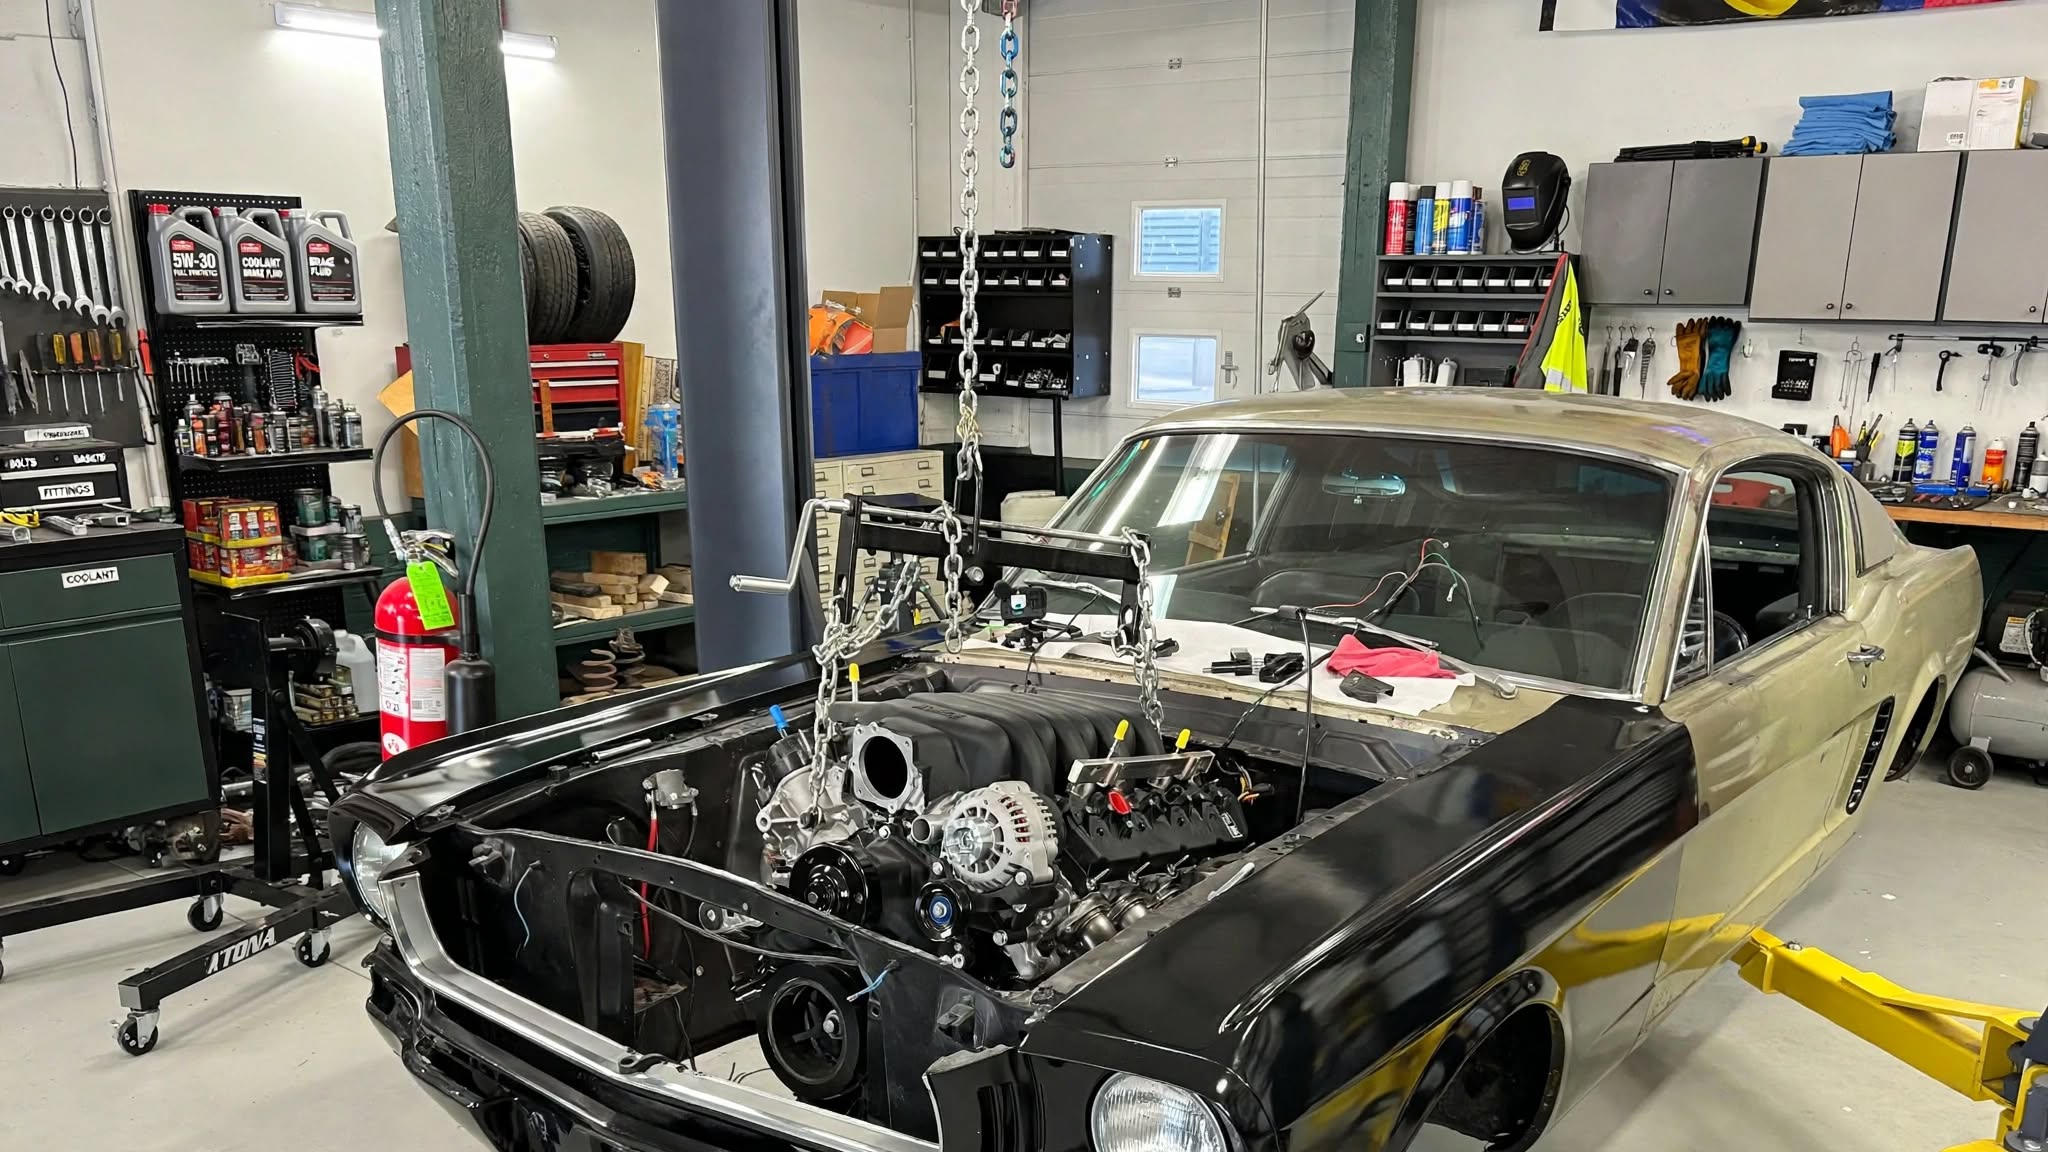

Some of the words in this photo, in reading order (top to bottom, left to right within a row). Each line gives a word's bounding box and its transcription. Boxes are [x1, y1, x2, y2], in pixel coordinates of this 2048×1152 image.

[172, 252, 216, 269] 5W-30
[242, 256, 281, 268] COOLANT
[43, 484, 91, 498] FITTINGS
[66, 569, 116, 584] COOLANT
